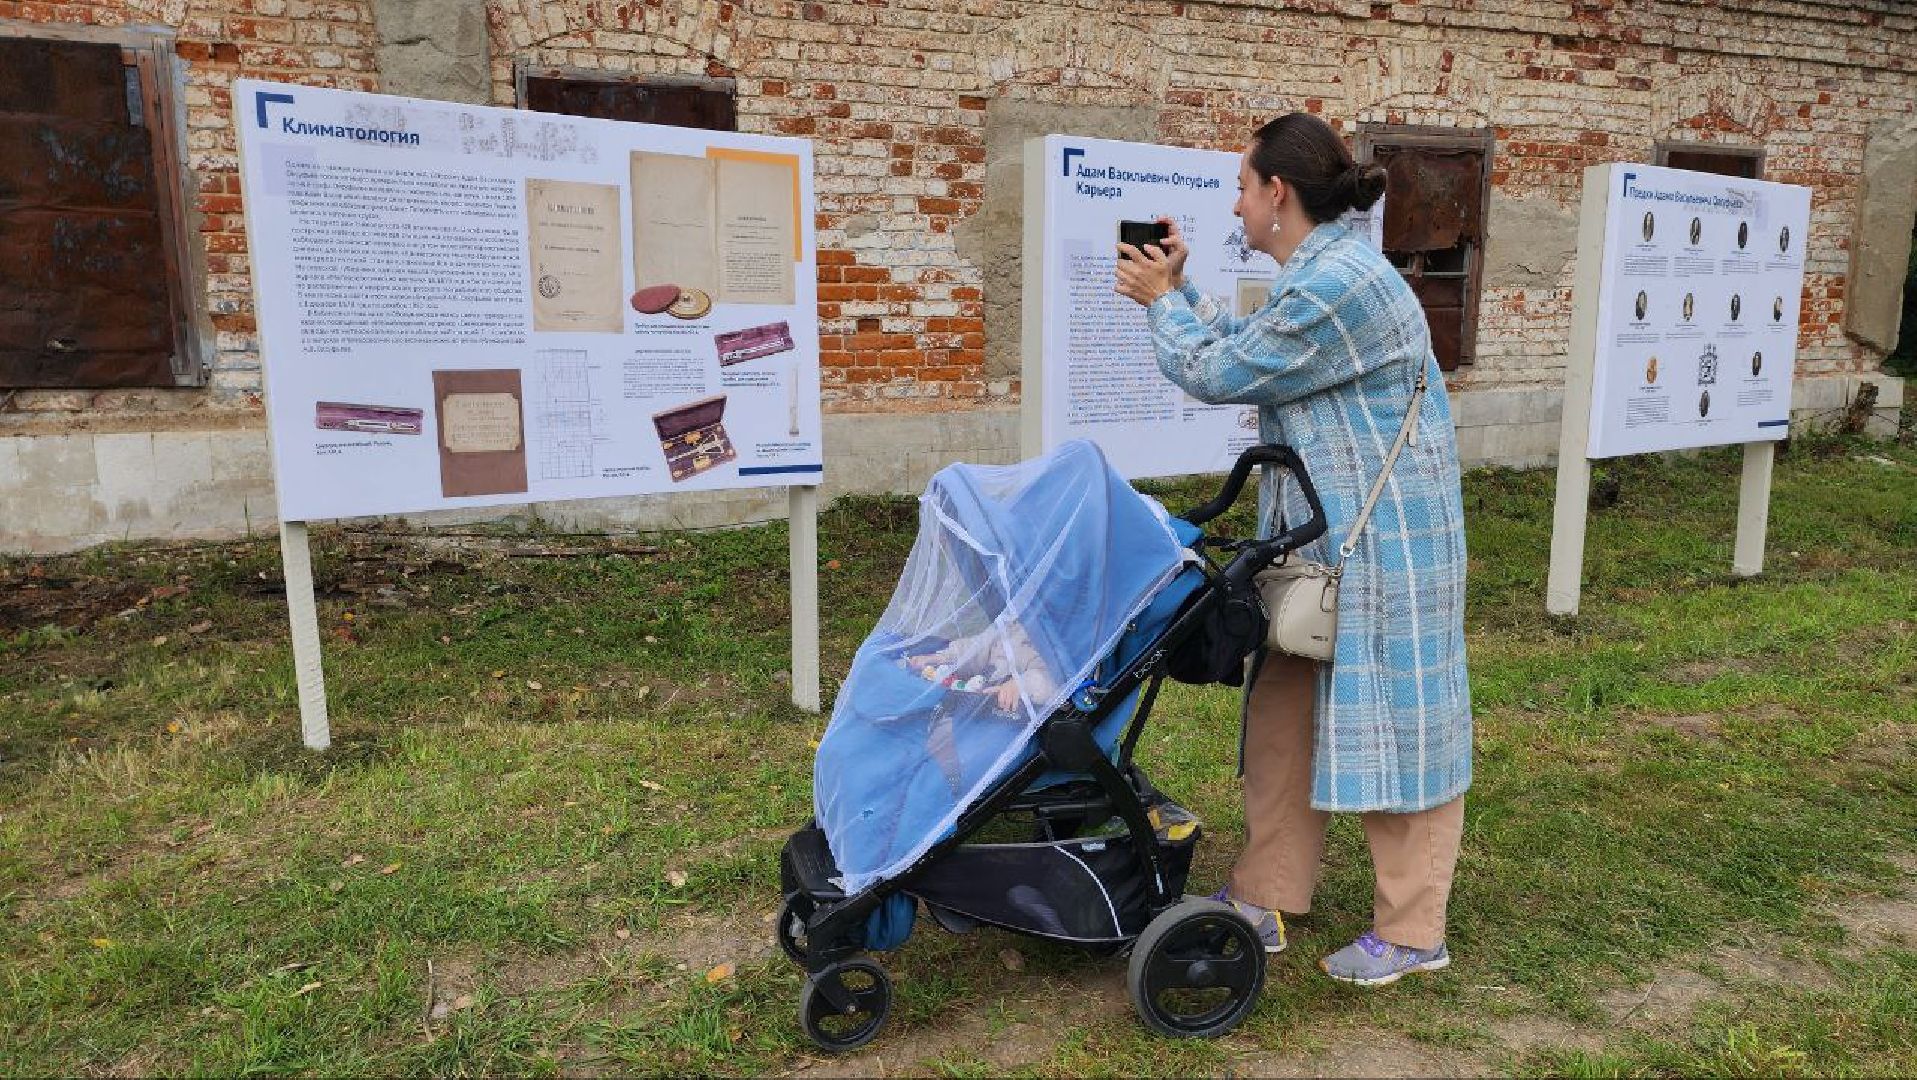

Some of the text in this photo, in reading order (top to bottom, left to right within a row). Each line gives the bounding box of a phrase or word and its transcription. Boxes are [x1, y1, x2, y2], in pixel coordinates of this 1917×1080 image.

[282, 117, 420, 146] Климатология
[1076, 164, 1220, 190] Адам Васильевич Олсуфьев
[1076, 181, 1122, 199] Карьера
